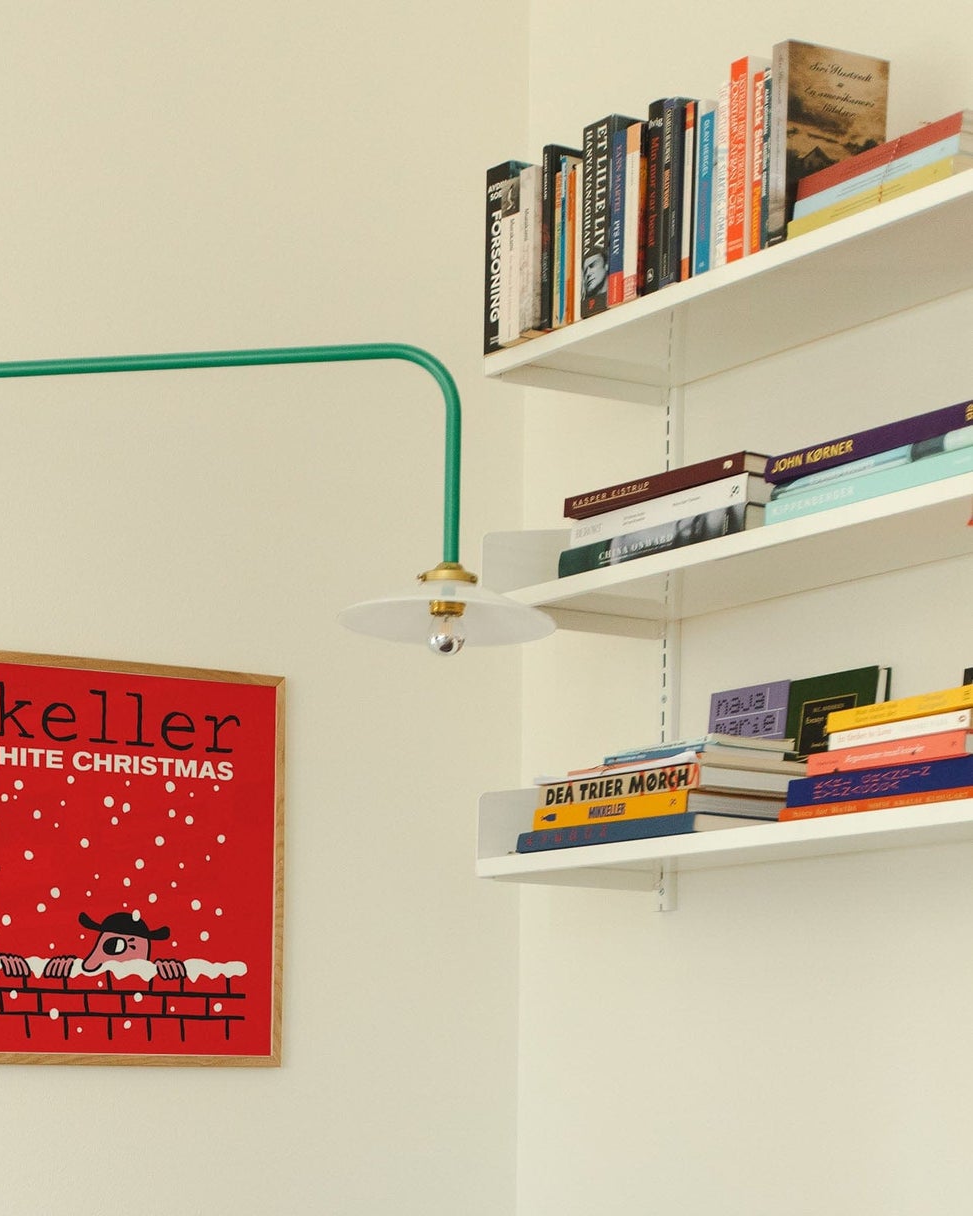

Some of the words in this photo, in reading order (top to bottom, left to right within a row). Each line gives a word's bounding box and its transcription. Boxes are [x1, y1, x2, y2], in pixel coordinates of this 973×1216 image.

[754, 81, 764, 125] Patrick
[585, 130, 593, 174] HANYA
[597, 123, 608, 152] ET
[651, 136, 660, 161] Min
[595, 156, 607, 213] LILLE
[649, 164, 657, 188] mor
[594, 216, 606, 249] LIV
[490, 210, 502, 324] FORSONING
[771, 452, 803, 474] JOHN
[806, 439, 854, 465] KØRNER
[572, 492, 606, 507] KASPER
[72, 750, 234, 781] CHRISTMAS
[545, 783, 574, 805] DEA
[579, 778, 623, 801] TRIER
[628, 768, 689, 795] MØRCH
